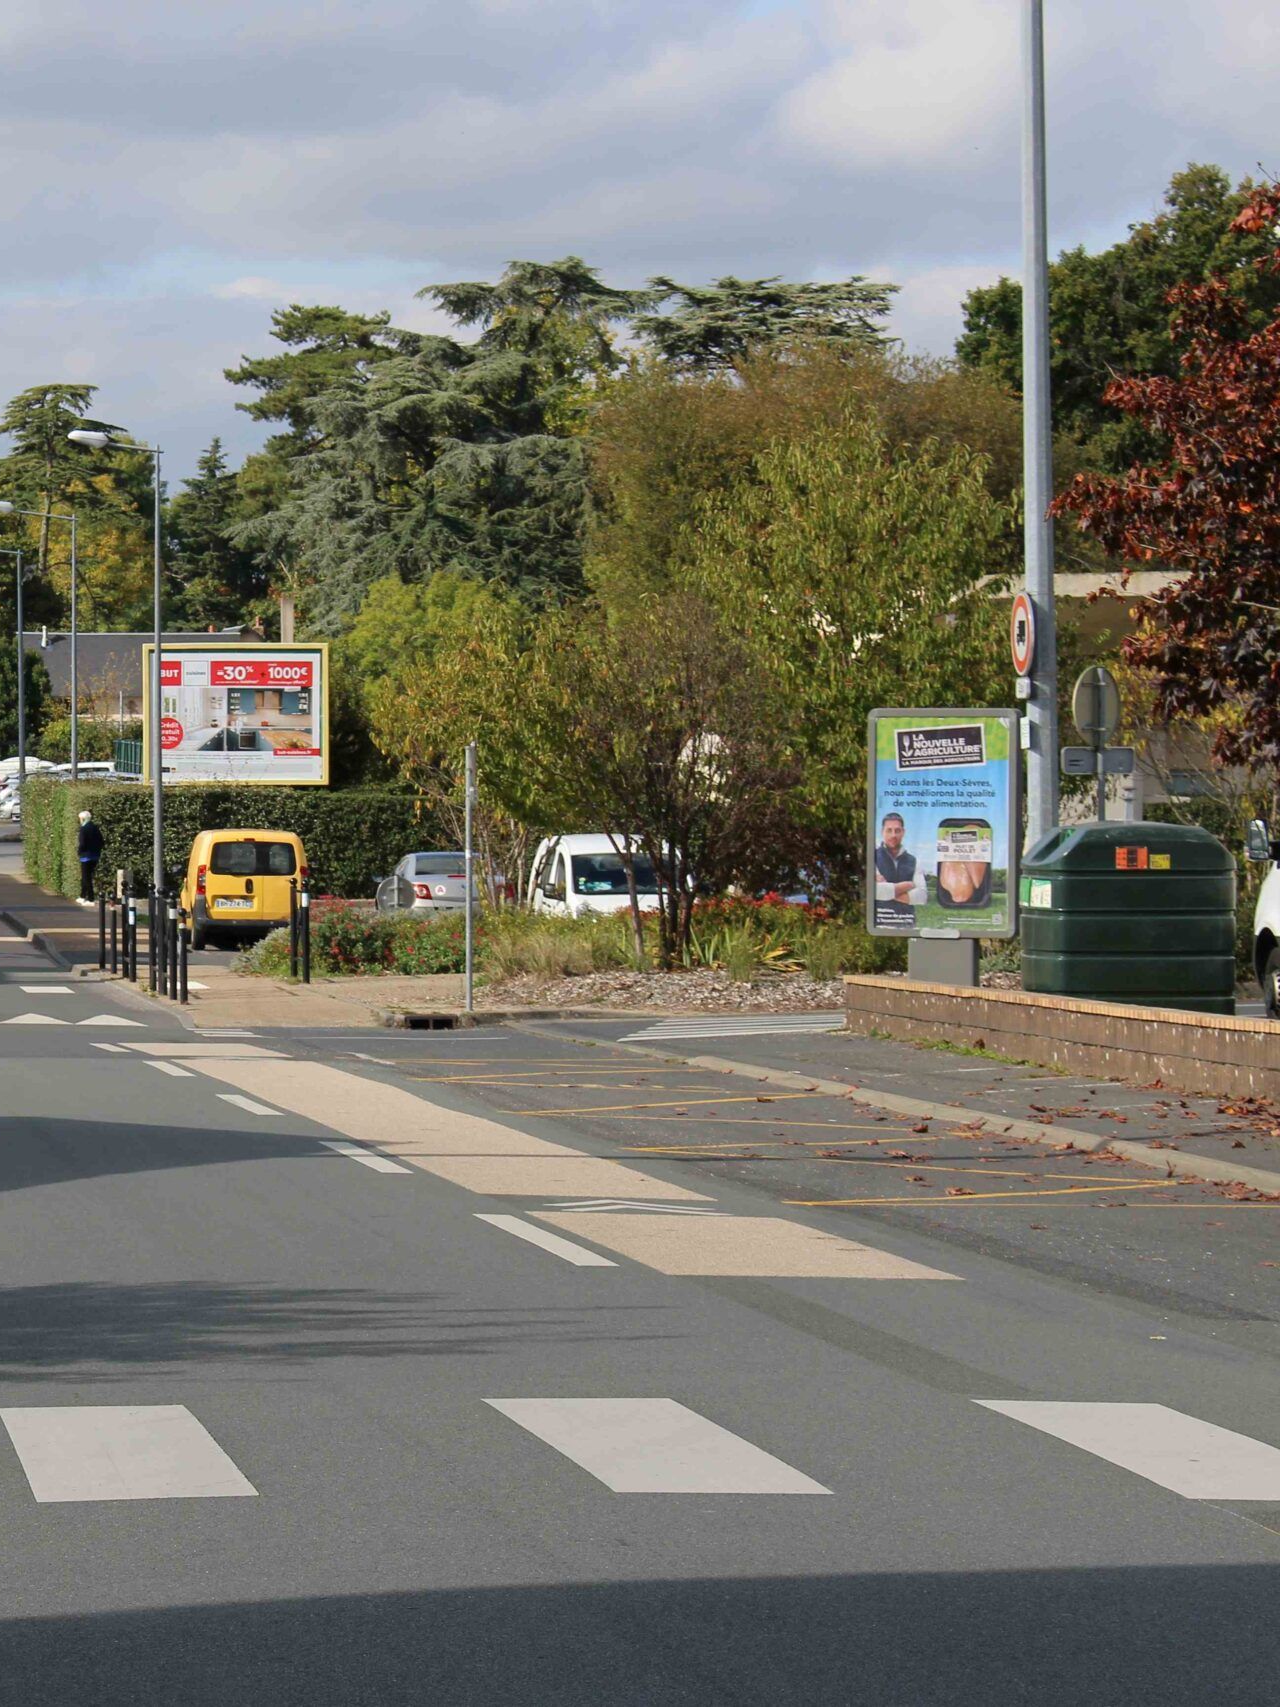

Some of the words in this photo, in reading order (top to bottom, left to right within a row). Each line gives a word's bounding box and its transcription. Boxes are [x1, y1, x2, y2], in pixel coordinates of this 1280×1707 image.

[268, 667, 308, 679] 1000€
[912, 733, 925, 741] LA
[913, 738, 966, 749] NOUVELLE
[914, 745, 981, 757] AGRICULTURE
[907, 789, 954, 797] améliorons
[957, 789, 965, 797] la
[966, 789, 996, 798] qualité
[893, 799, 904, 807] de
[931, 799, 988, 808] alimentation.
